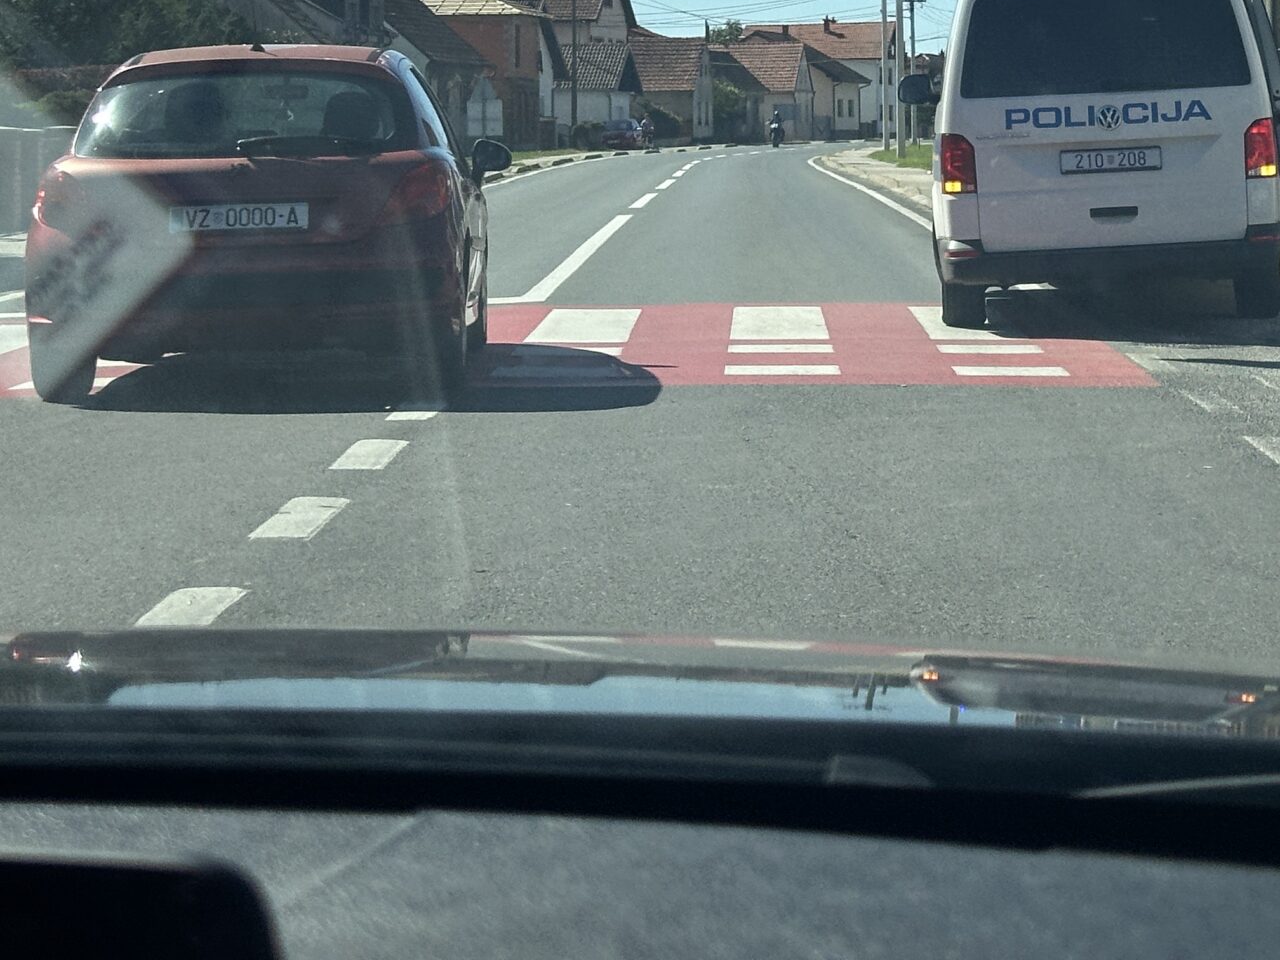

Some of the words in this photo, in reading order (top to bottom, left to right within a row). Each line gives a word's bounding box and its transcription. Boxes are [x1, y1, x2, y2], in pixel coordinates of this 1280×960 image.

[1005, 100, 1212, 130] POLICIJA
[1075, 153, 1104, 170] 210
[1118, 151, 1147, 168] 208
